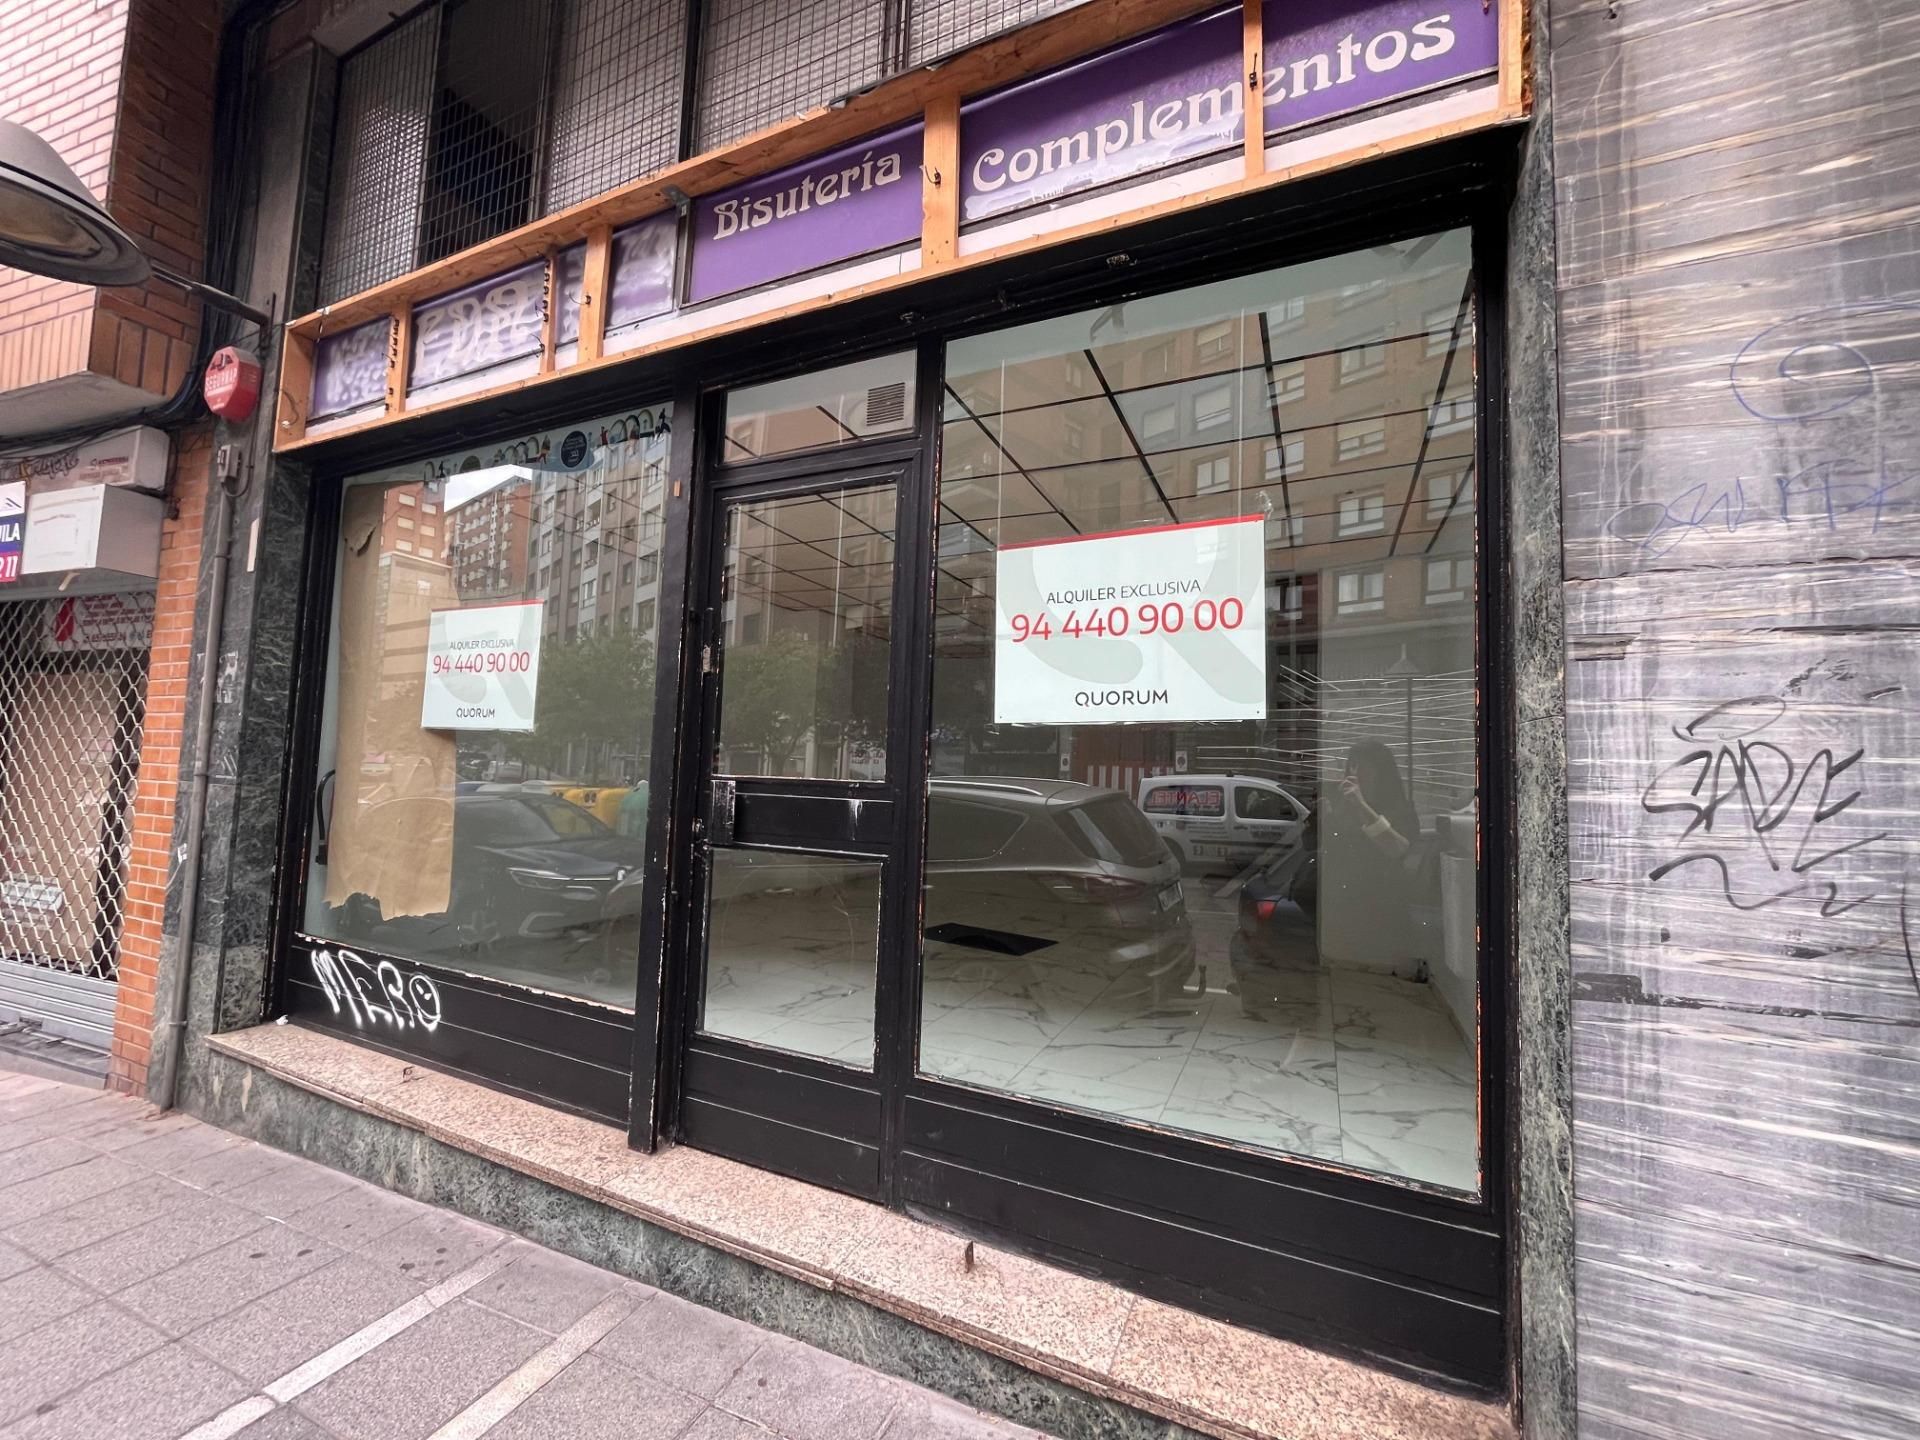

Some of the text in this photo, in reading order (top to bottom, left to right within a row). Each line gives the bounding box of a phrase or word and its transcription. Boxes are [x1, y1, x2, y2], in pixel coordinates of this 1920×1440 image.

[713, 151, 902, 240] Bisutería
[1046, 578, 1201, 605] ALQUILER EXCLUSIVA
[1011, 597, 1244, 643] 94 440 90 00
[450, 638, 515, 651] ALQUILER EXCLUSIVA
[433, 651, 530, 674] 94 440 90 00
[1075, 689, 1168, 707] QUORUM
[456, 707, 496, 718] QUORUM
